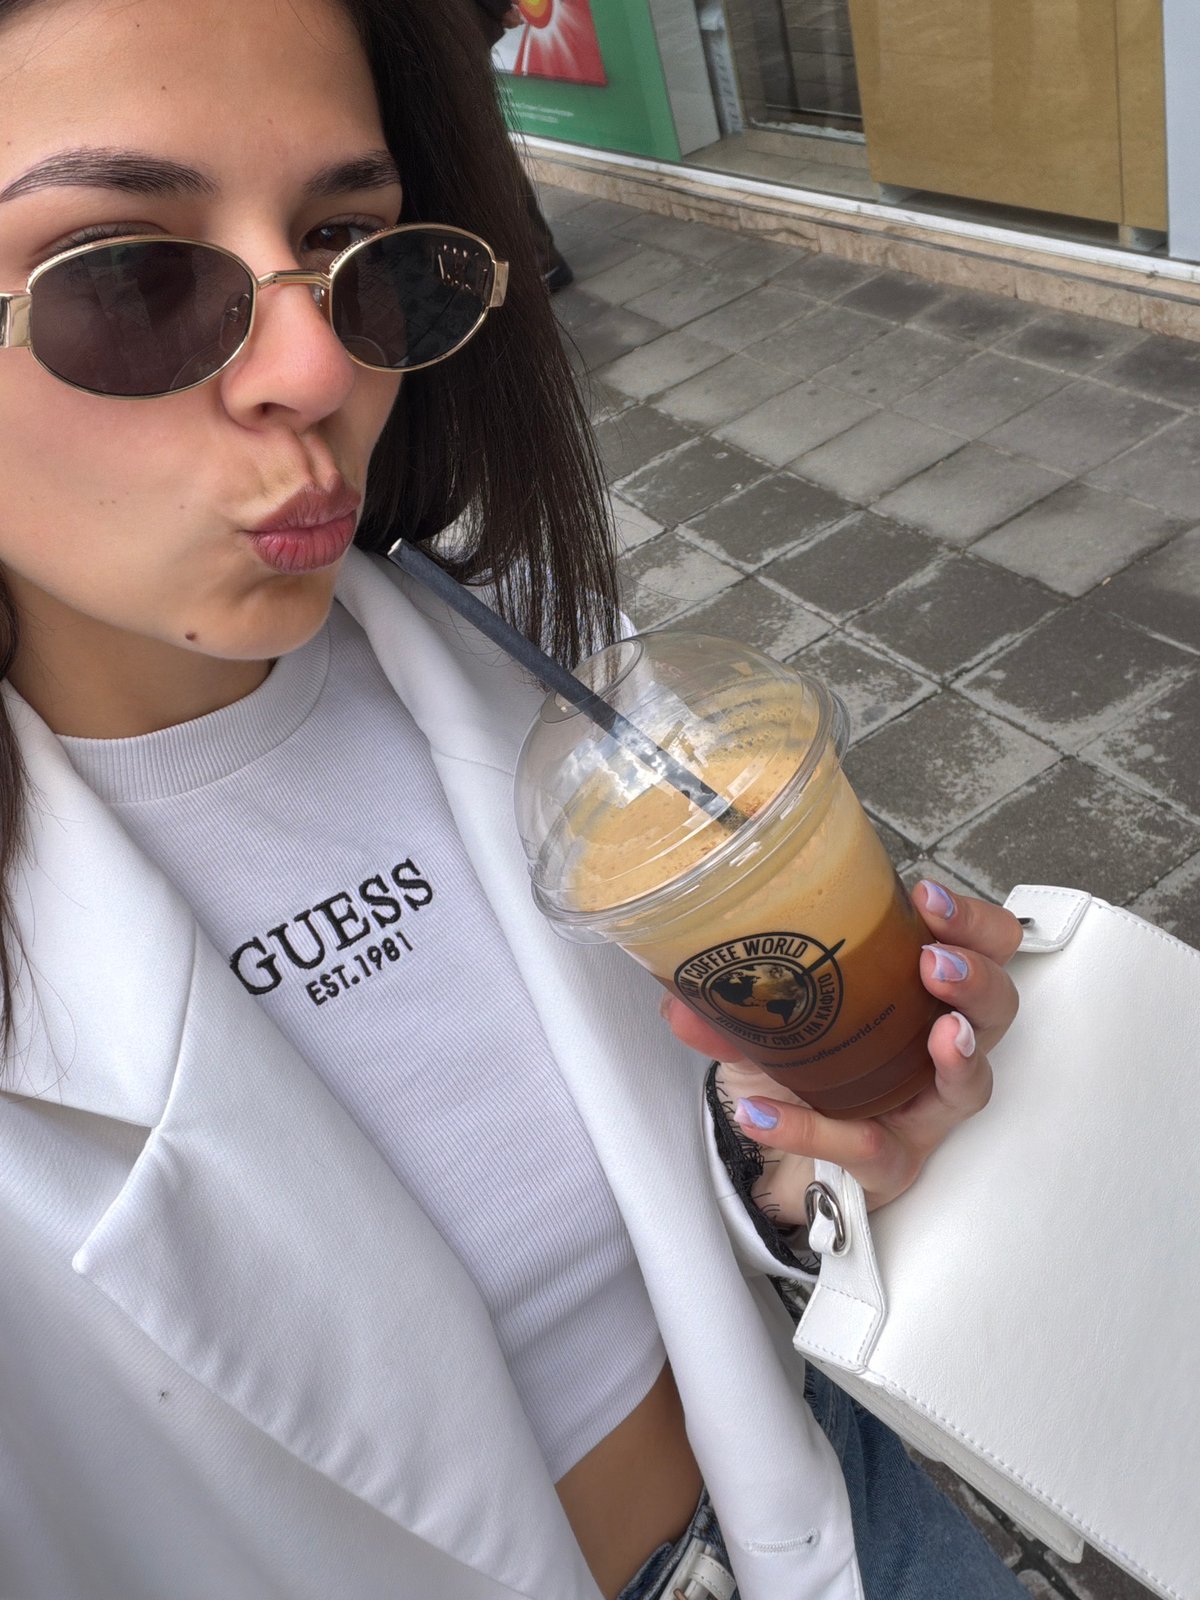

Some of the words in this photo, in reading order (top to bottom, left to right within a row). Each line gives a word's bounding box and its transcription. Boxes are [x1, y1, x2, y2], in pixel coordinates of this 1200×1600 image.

[229, 857, 433, 996] GUESS
[684, 944, 742, 980] COFFEE
[742, 937, 809, 959] WORLD
[679, 975, 701, 999] NEW
[803, 1021, 824, 1036] НА
[814, 972, 836, 1021] КАФЕТО
